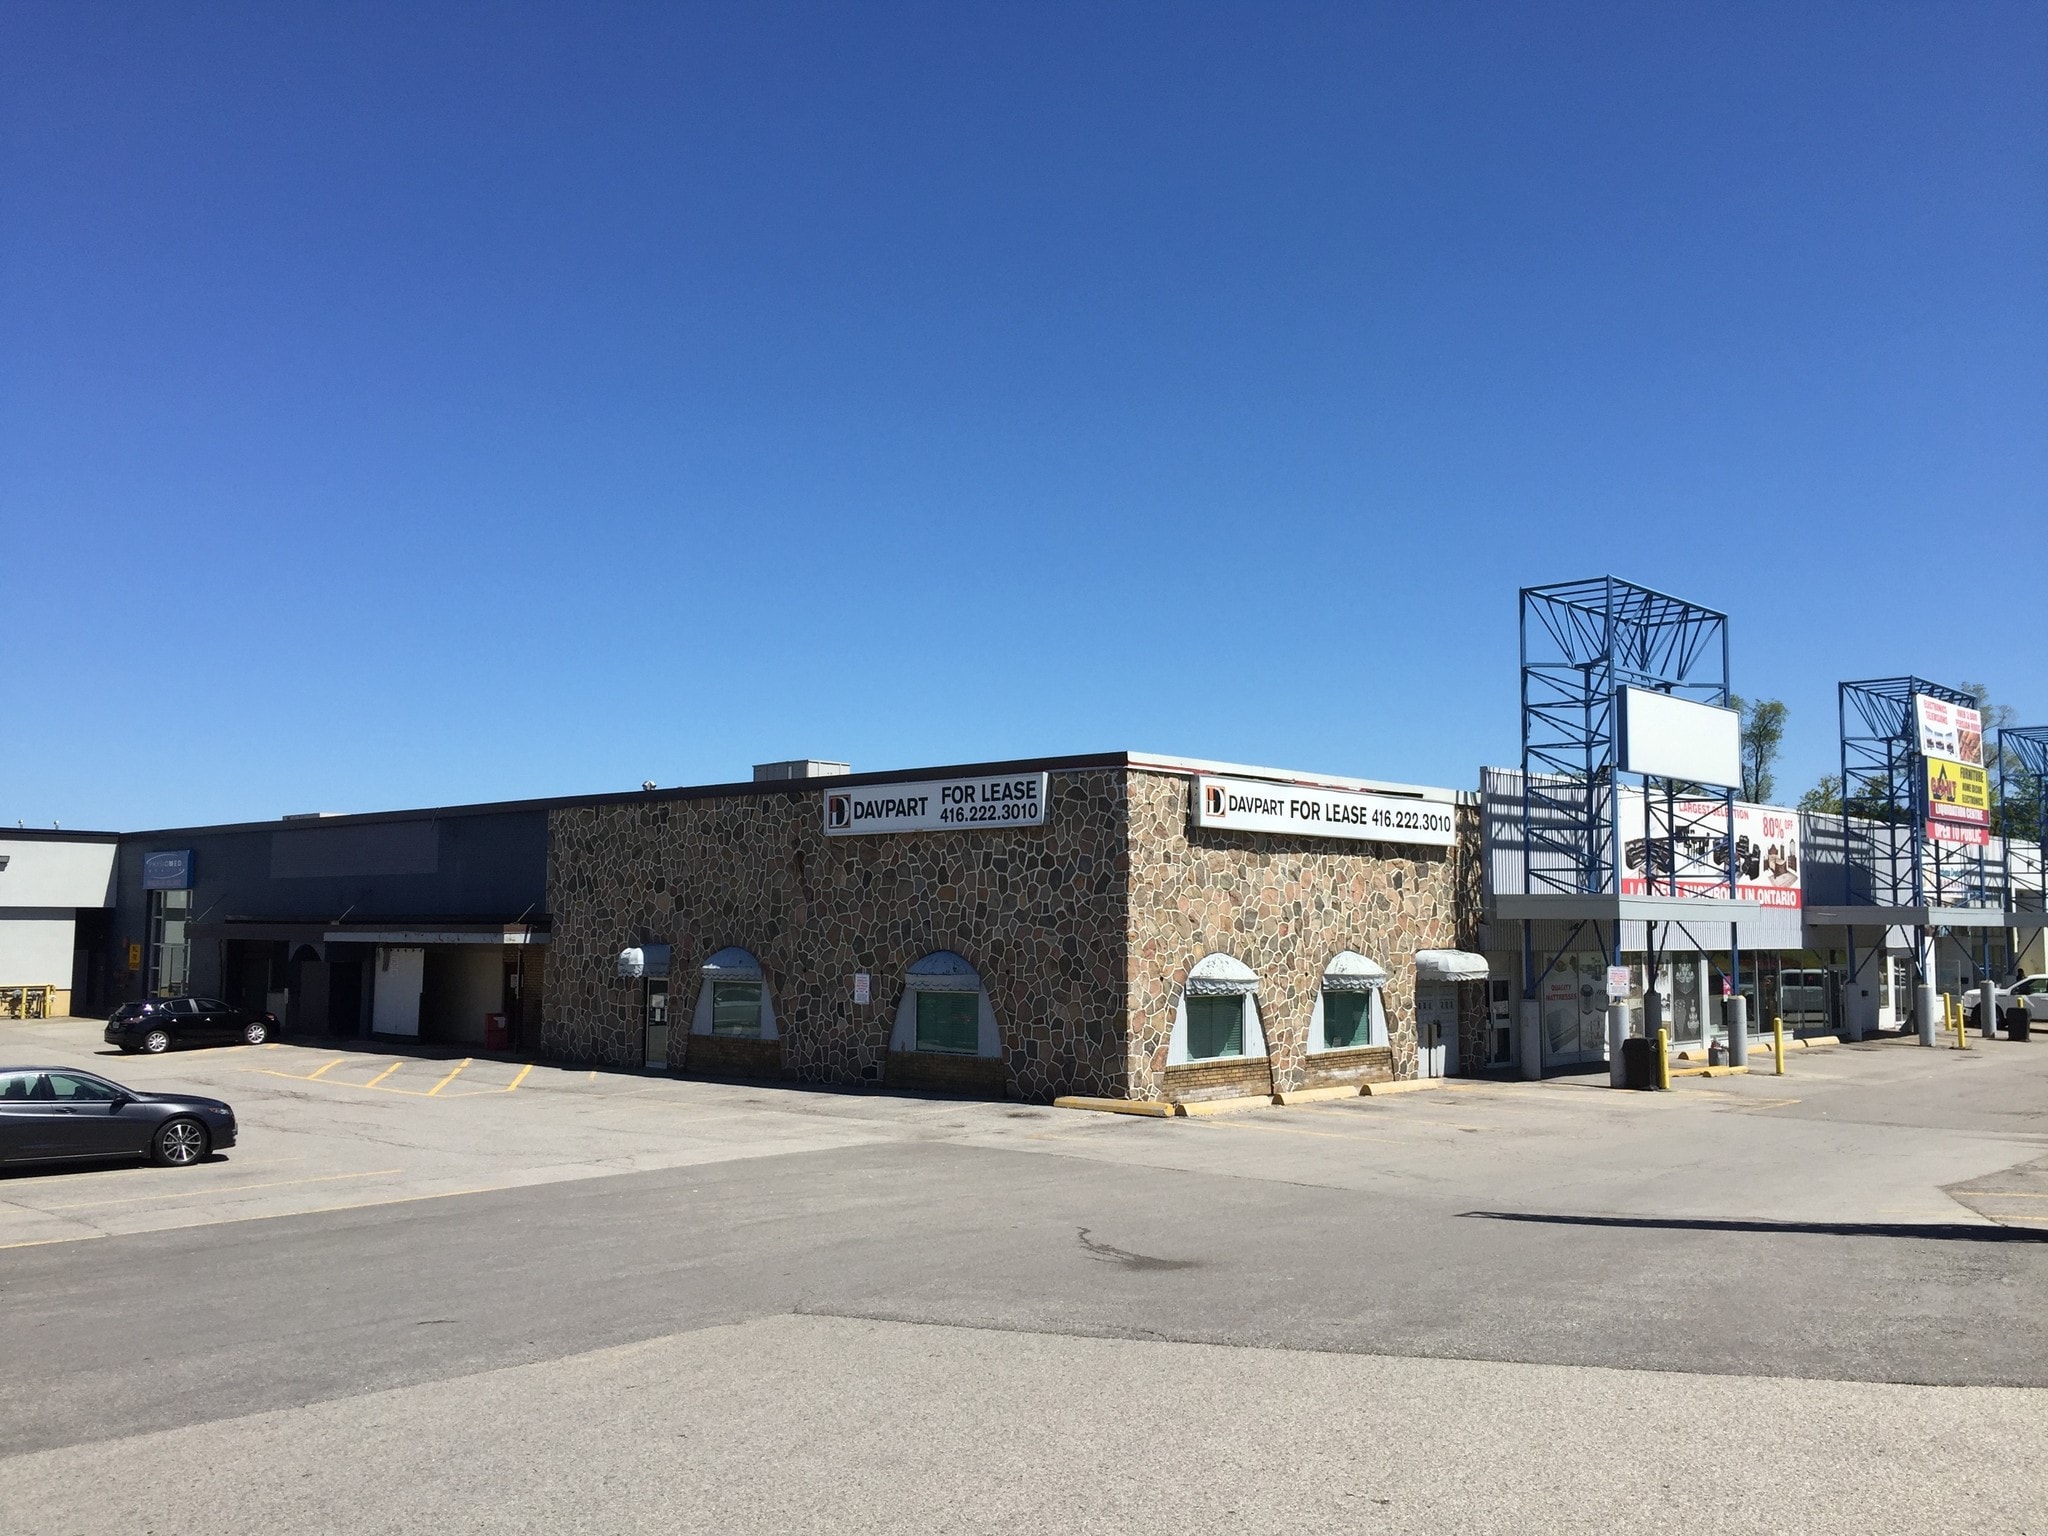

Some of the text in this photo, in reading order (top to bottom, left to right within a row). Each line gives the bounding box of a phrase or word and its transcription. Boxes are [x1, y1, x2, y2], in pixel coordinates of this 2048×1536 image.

[1960, 767, 1984, 783] FURNITURE
[941, 781, 1037, 805] FOR LEASE
[1962, 783, 1972, 792] HOME
[854, 797, 929, 820] DAVPART
[940, 803, 1038, 823] 416.222.3010
[1229, 795, 1451, 833] DAVPART FOR LEASE 416.222.3010
[1679, 802, 1749, 820] LARGEST SELETION
[1935, 803, 1984, 821] LIQUIDATION CENTRE
[1763, 816, 1794, 839] 80% OFF
[1935, 822, 1982, 843] OPEN TO PUBLIC
[1745, 887, 1756, 901] IN
[1757, 889, 1797, 907] ONTARIO
